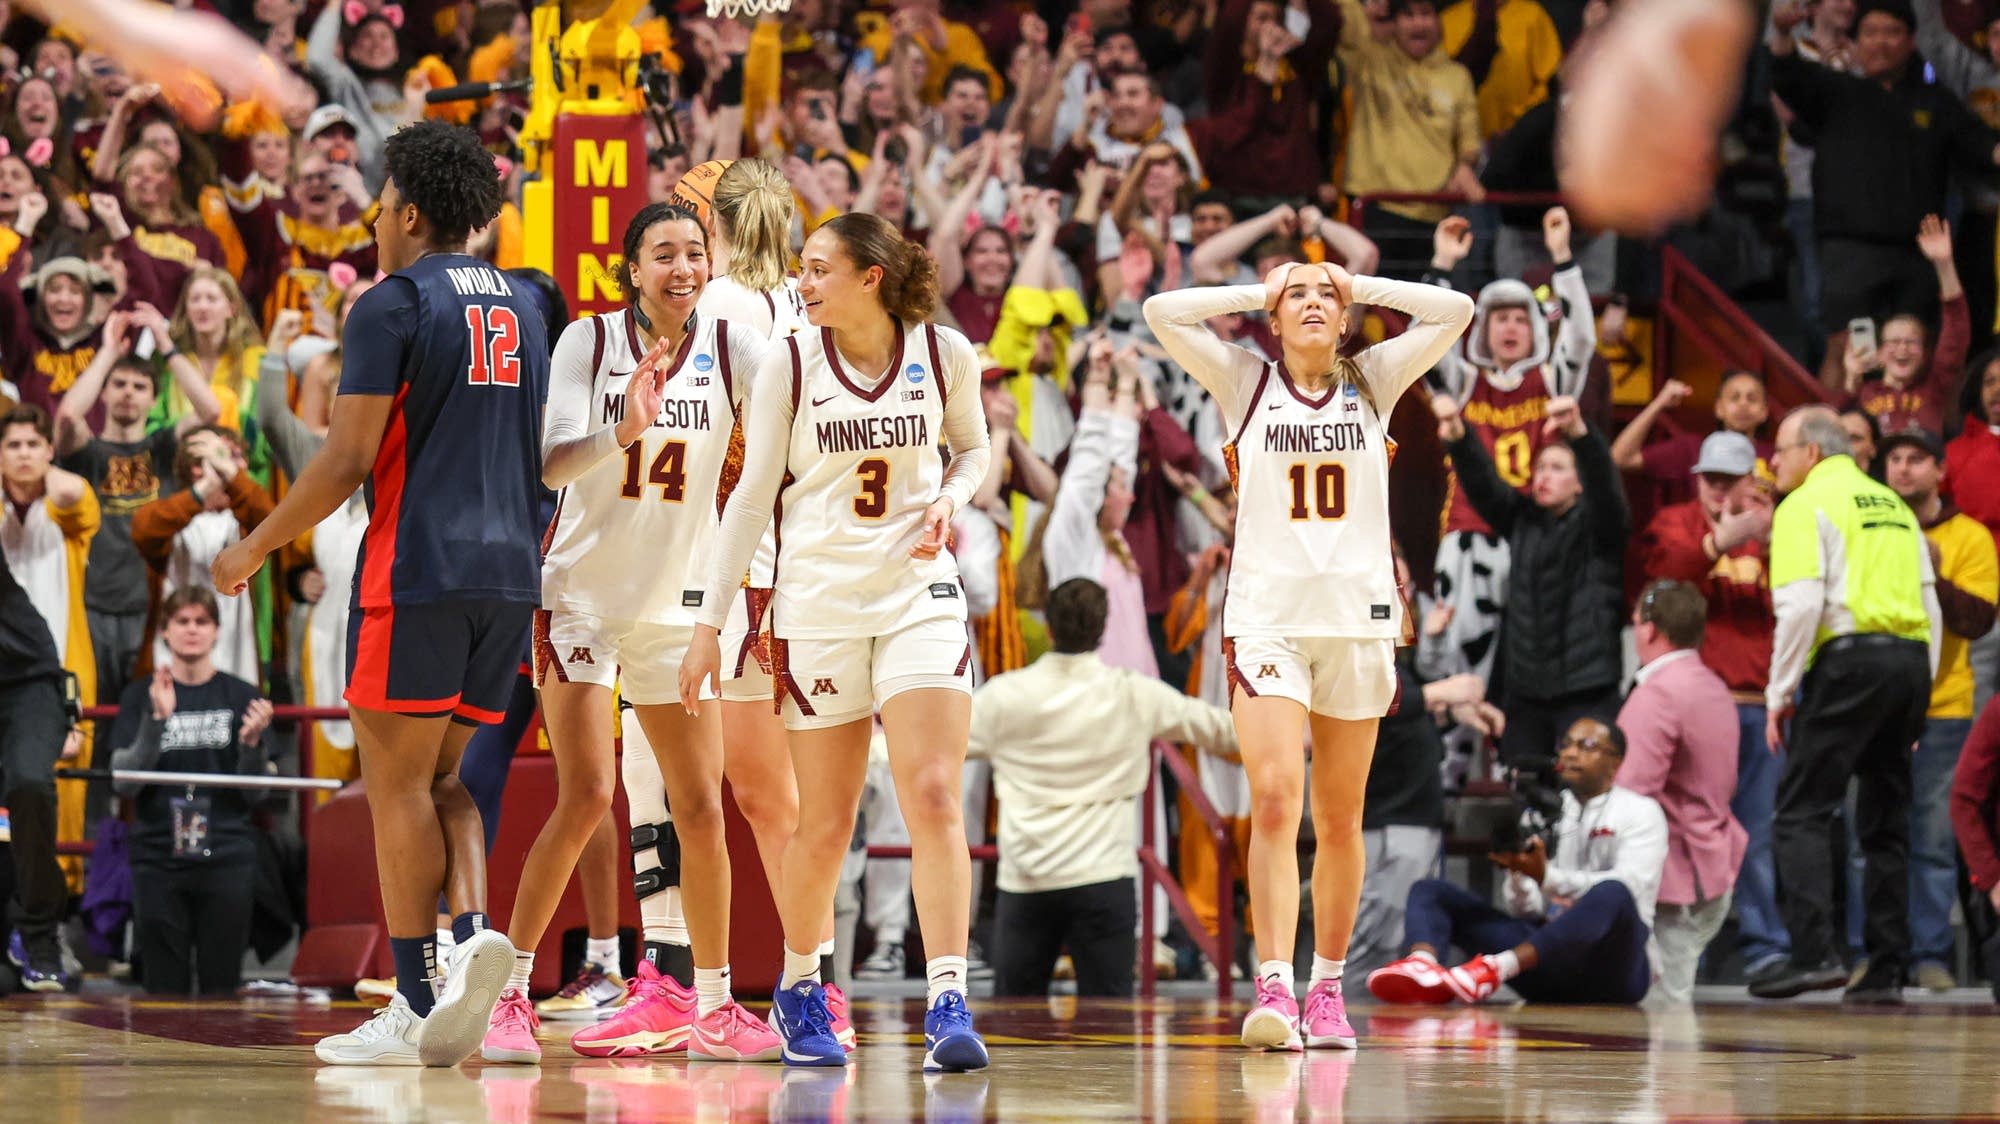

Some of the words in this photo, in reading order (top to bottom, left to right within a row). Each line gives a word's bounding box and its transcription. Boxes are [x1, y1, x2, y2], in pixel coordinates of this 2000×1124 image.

[574, 138, 628, 319] MIN
[446, 266, 513, 297] IWUALA
[465, 304, 521, 388] 12
[602, 393, 711, 431] MIESOTA
[815, 414, 928, 454] MINNESOTA
[1264, 422, 1367, 453] MINNESOTA
[620, 438, 688, 504] 14
[1494, 430, 1532, 488] 0
[852, 456, 891, 521] 3
[1288, 462, 1347, 521] 10
[567, 646, 595, 665] M
[1256, 664, 1281, 678] M
[810, 677, 839, 697] M
